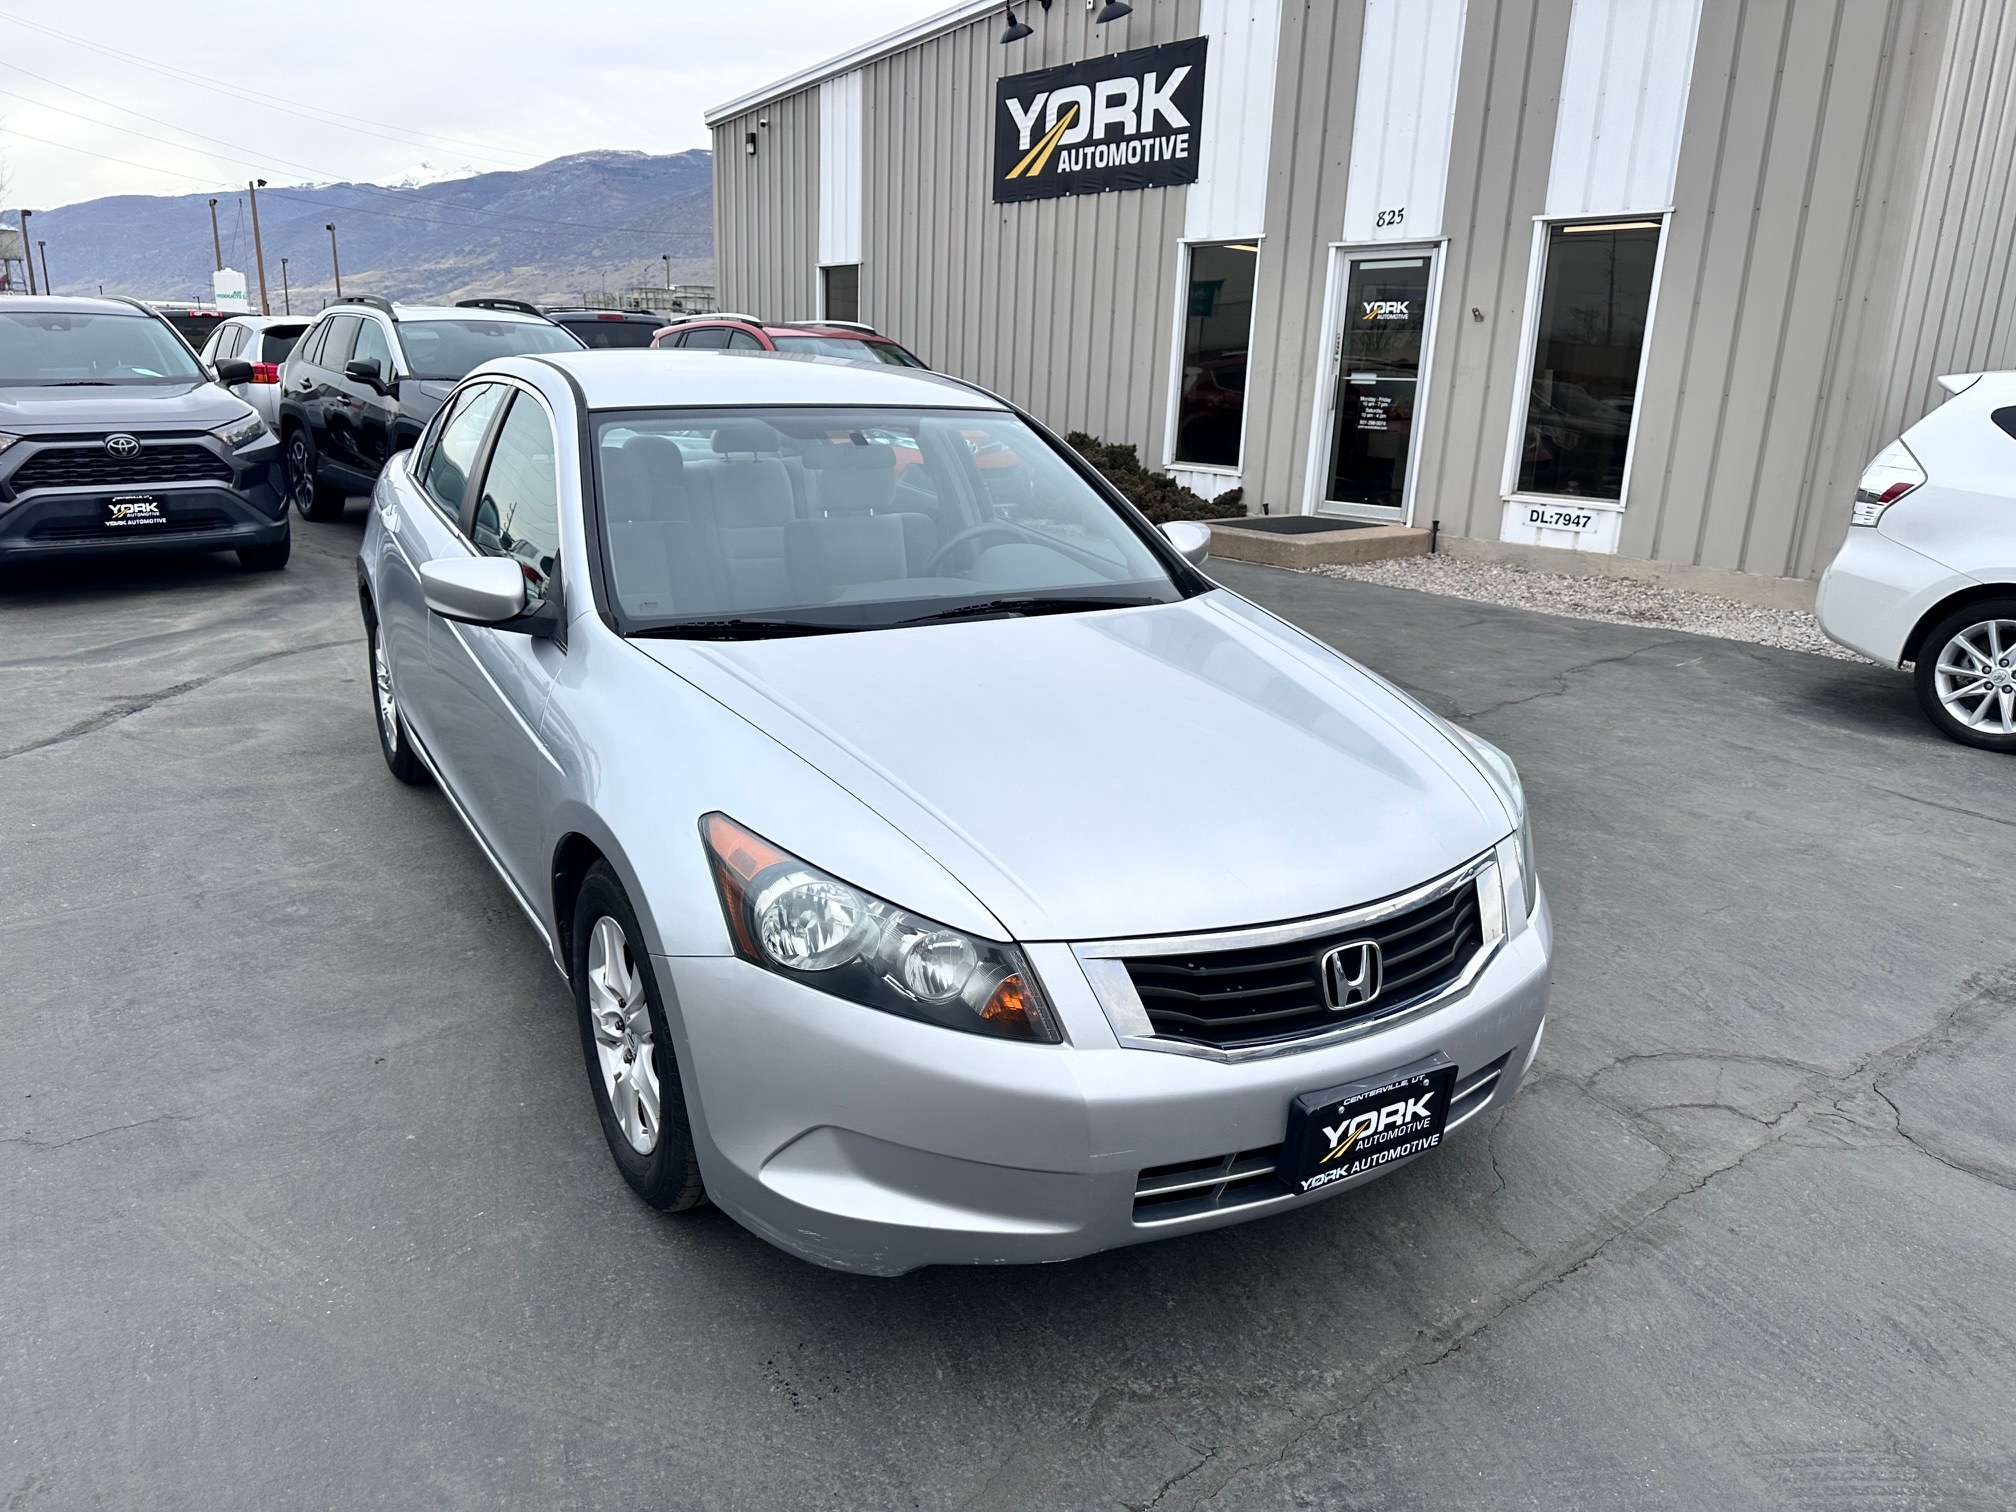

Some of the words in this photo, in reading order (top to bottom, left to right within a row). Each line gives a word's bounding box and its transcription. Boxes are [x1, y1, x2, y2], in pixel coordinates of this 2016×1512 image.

[1004, 65, 1193, 151] YORK
[1057, 133, 1190, 173] AUTOMOTIVE
[1376, 207, 1405, 228] 825
[1363, 301, 1410, 314] YORK
[108, 502, 159, 514] YORK
[1529, 509, 1592, 528] DL:7947
[1411, 1074, 1426, 1084] UT
[1322, 1091, 1435, 1148] YORK
[1355, 1117, 1431, 1151] AUTOMOTIVE
[1300, 1164, 1350, 1191] YORK
[1350, 1133, 1440, 1174] AUTOMOTIVE
